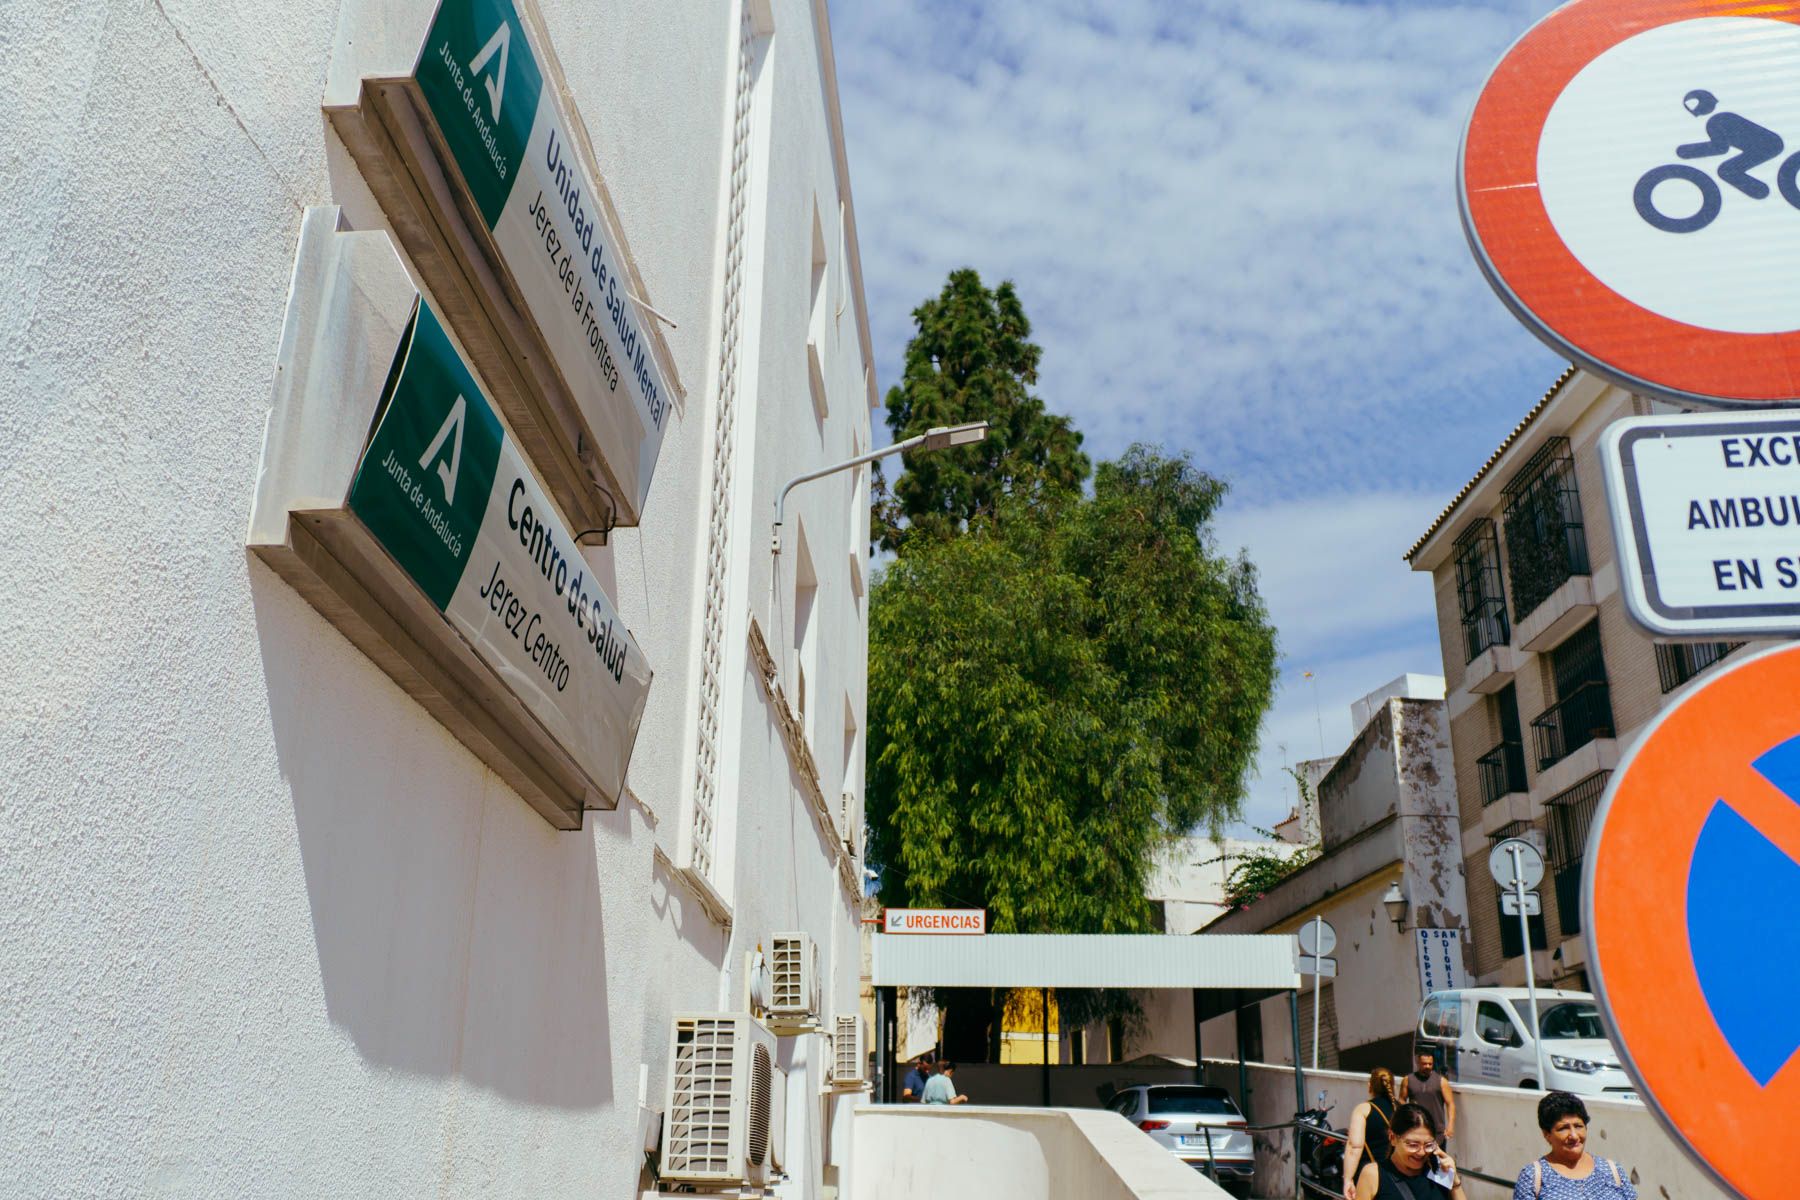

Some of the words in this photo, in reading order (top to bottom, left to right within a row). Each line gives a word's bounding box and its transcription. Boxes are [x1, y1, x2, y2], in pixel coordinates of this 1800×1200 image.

[439, 41, 465, 92] Junta
[463, 88, 474, 112] de
[472, 106, 507, 180] Andalucía
[529, 190, 562, 265] Jerez
[559, 253, 574, 293] de
[571, 276, 584, 316] la
[582, 300, 619, 393] Frontera
[547, 128, 594, 256] Unidad
[592, 245, 607, 292] de
[606, 276, 637, 361] Salud
[633, 344, 665, 431] Mental
[382, 449, 412, 494] Junta
[410, 483, 424, 509] de
[421, 498, 462, 559] Andalucía
[480, 561, 526, 640] Jerez
[524, 613, 570, 693] Centro
[507, 477, 567, 597] Centro
[567, 570, 588, 628] de
[587, 600, 628, 685] Salud
[1713, 558, 1764, 591] EN
[1775, 557, 1800, 589] S
[906, 915, 980, 929] URGENCIAS
